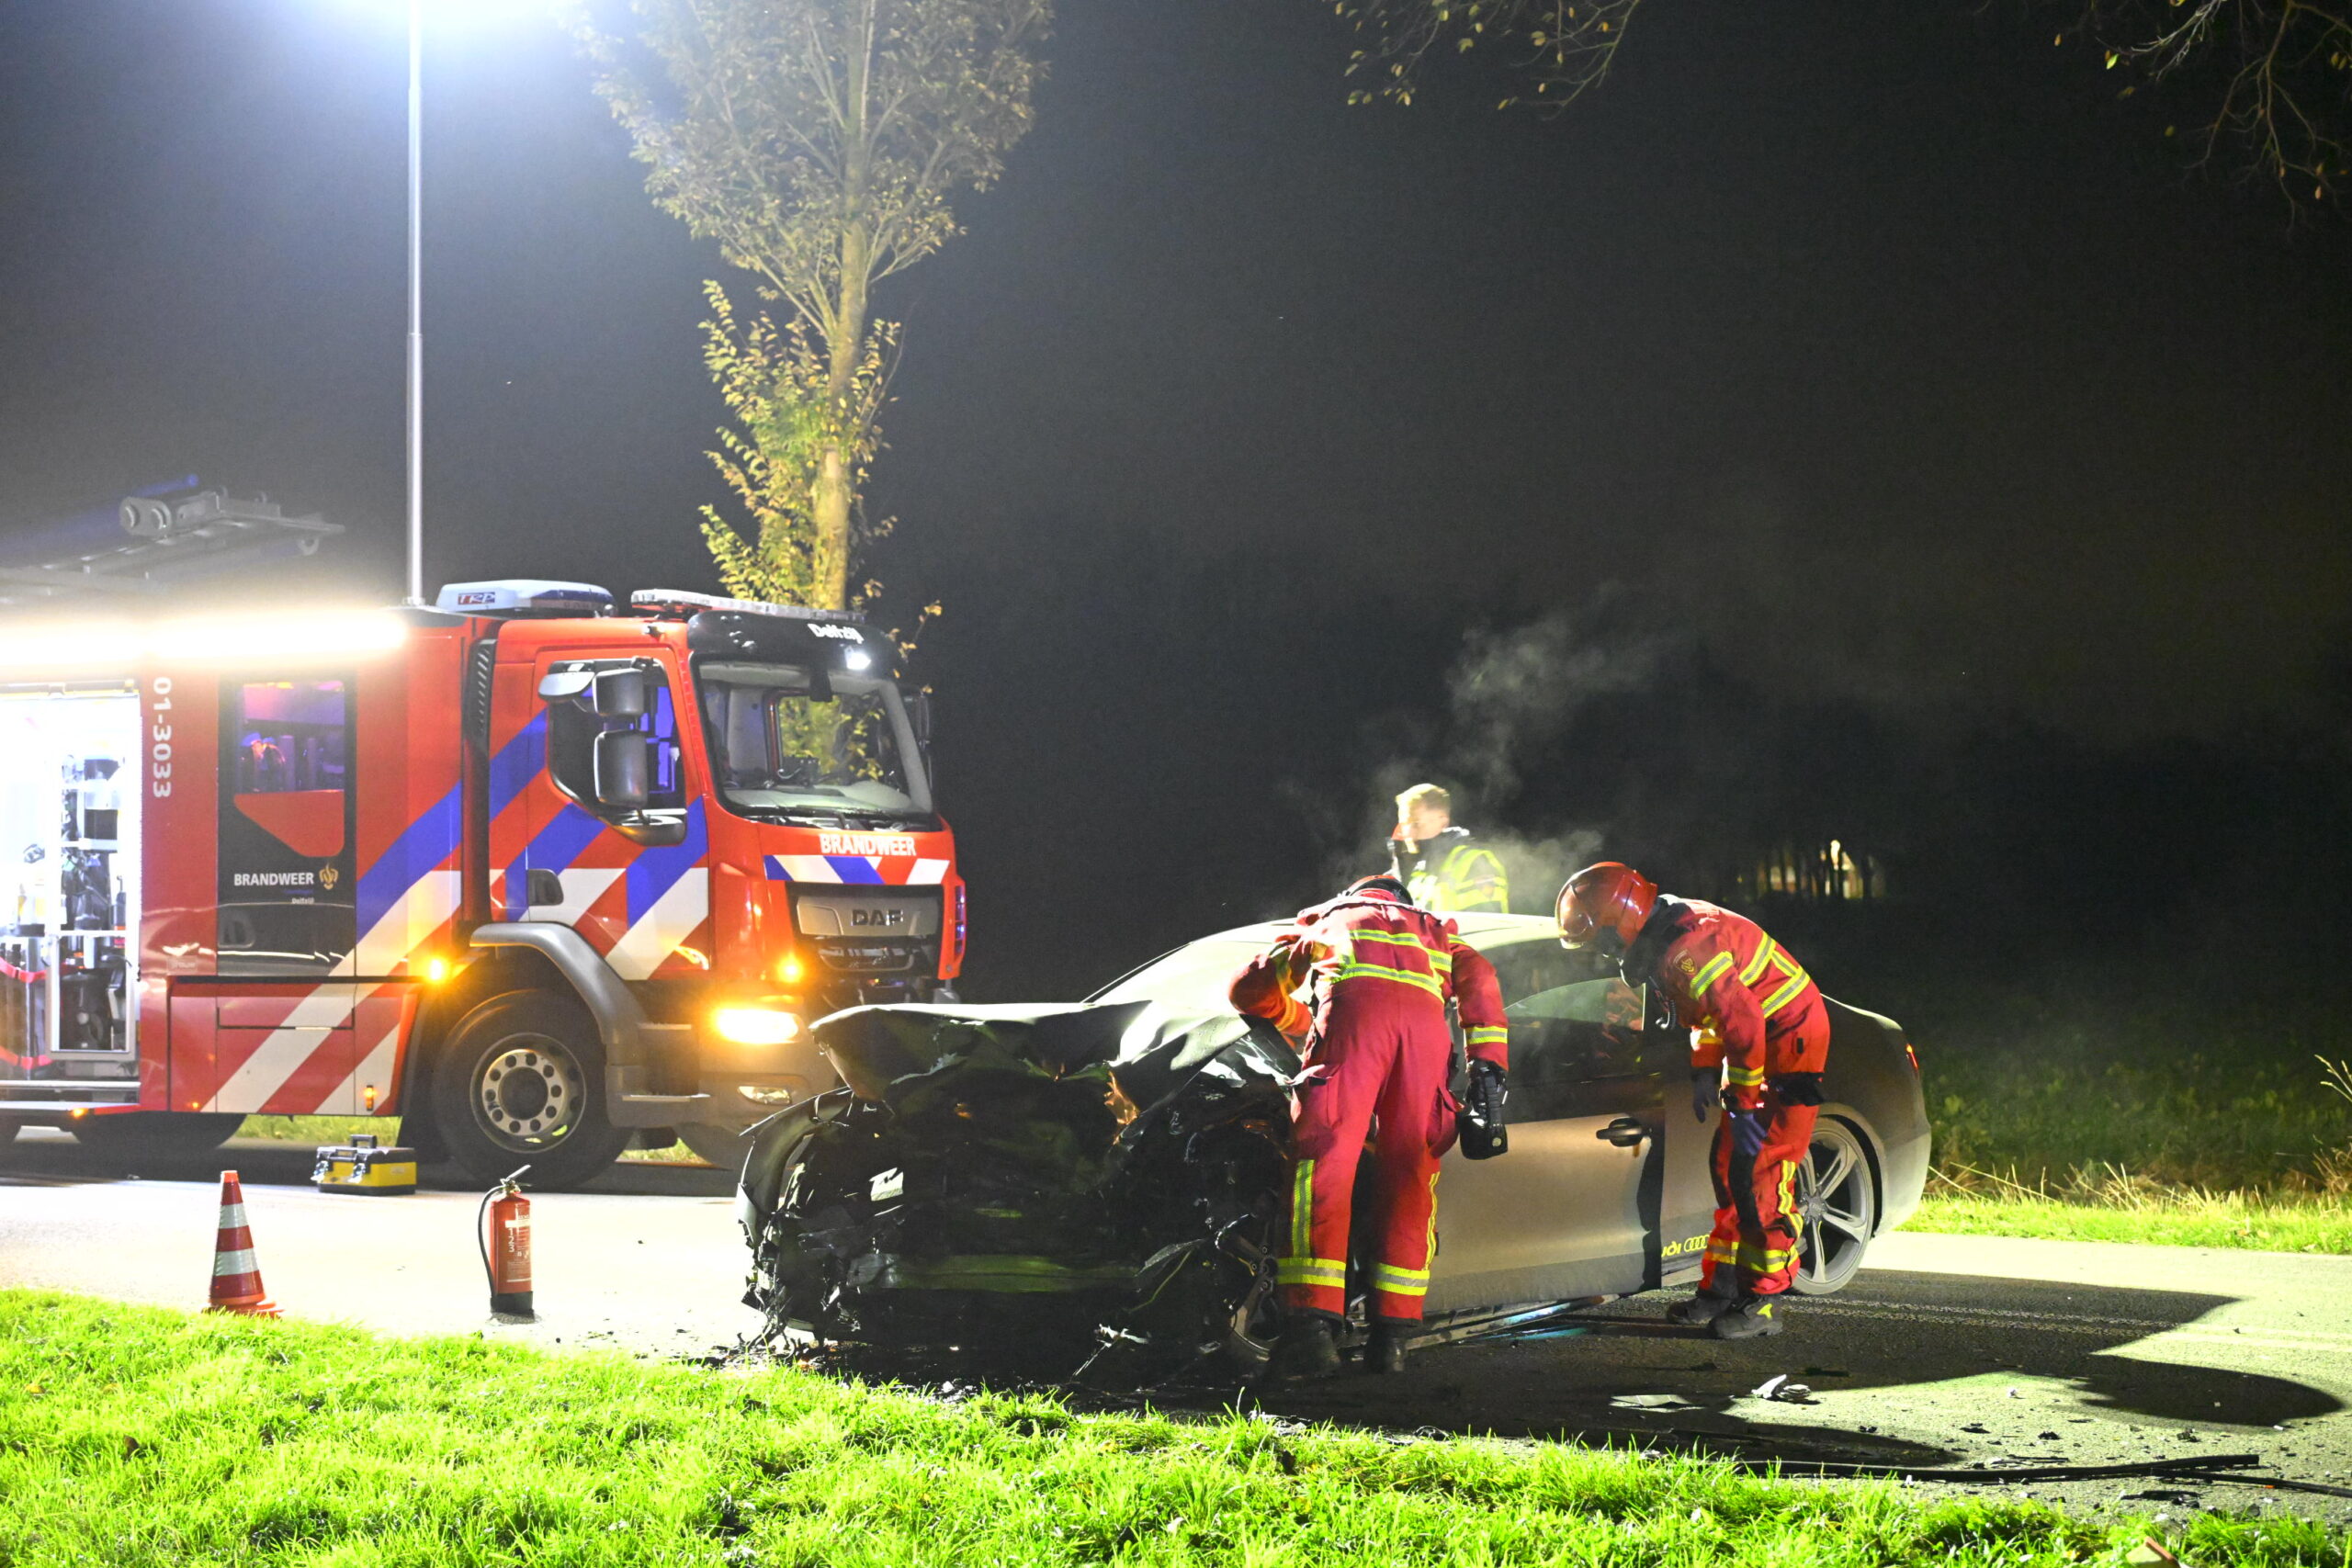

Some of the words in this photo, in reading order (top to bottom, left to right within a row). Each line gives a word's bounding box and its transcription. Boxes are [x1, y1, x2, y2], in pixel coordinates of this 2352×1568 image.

[153, 677, 172, 797] 01-3033
[819, 833, 917, 856] BRANDWEER
[233, 872, 314, 886] BRANDWEER
[850, 908, 904, 926] DAF
[508, 1227, 514, 1235] 1
[508, 1235, 514, 1245] 2
[508, 1244, 515, 1253] 3
